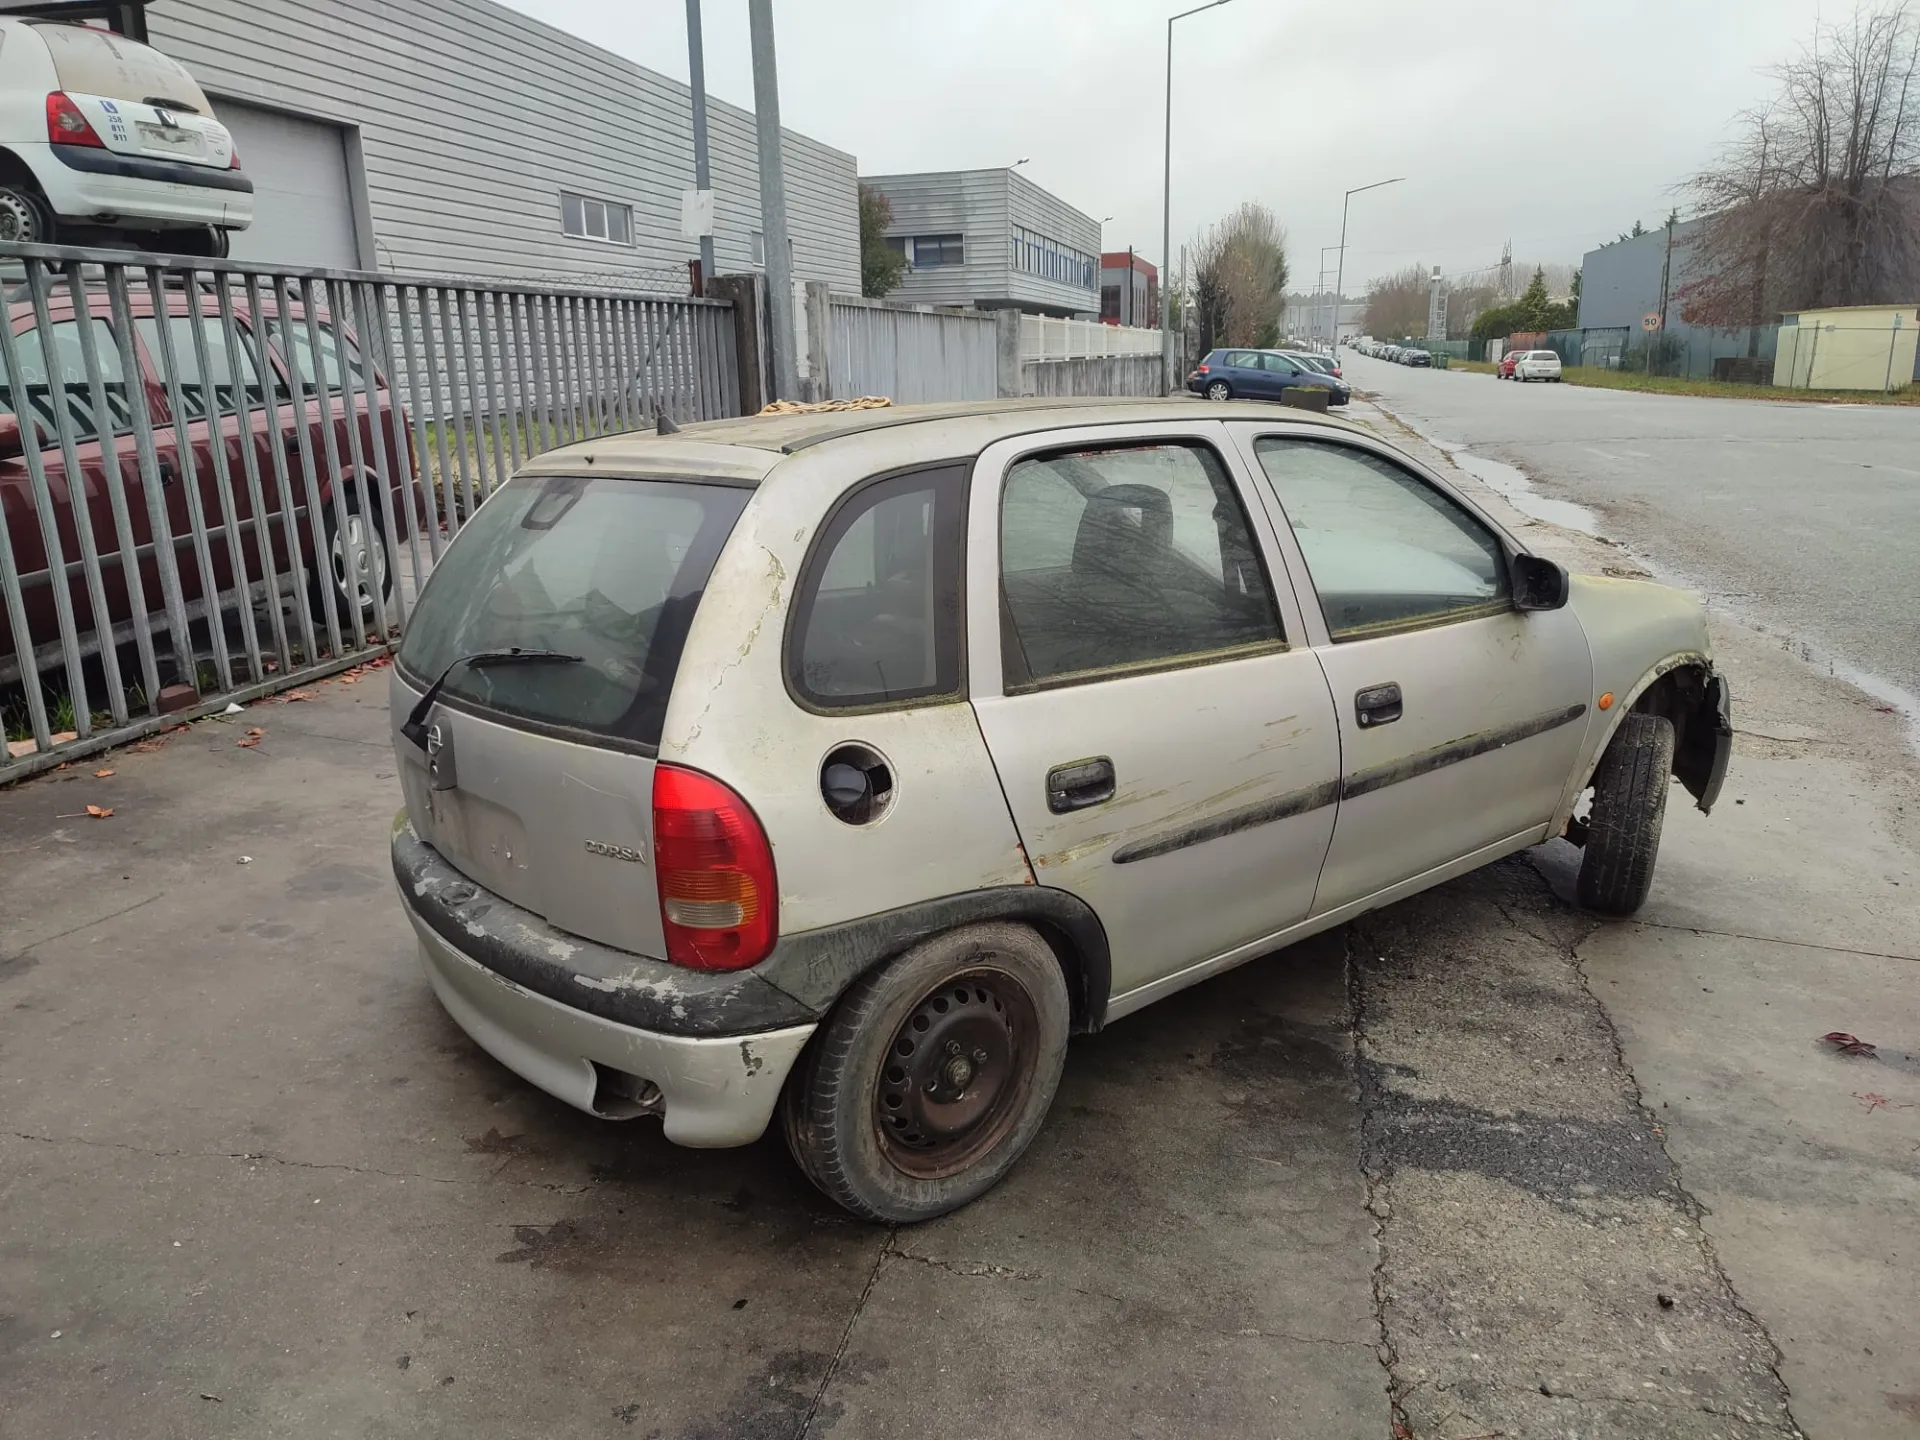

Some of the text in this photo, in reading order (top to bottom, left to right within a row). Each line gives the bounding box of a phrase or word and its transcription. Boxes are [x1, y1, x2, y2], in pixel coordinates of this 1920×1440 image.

[108, 115, 122, 123] 258
[113, 133, 127, 142] 911
[1644, 318, 1657, 326] 50
[584, 839, 646, 864] CORSA
